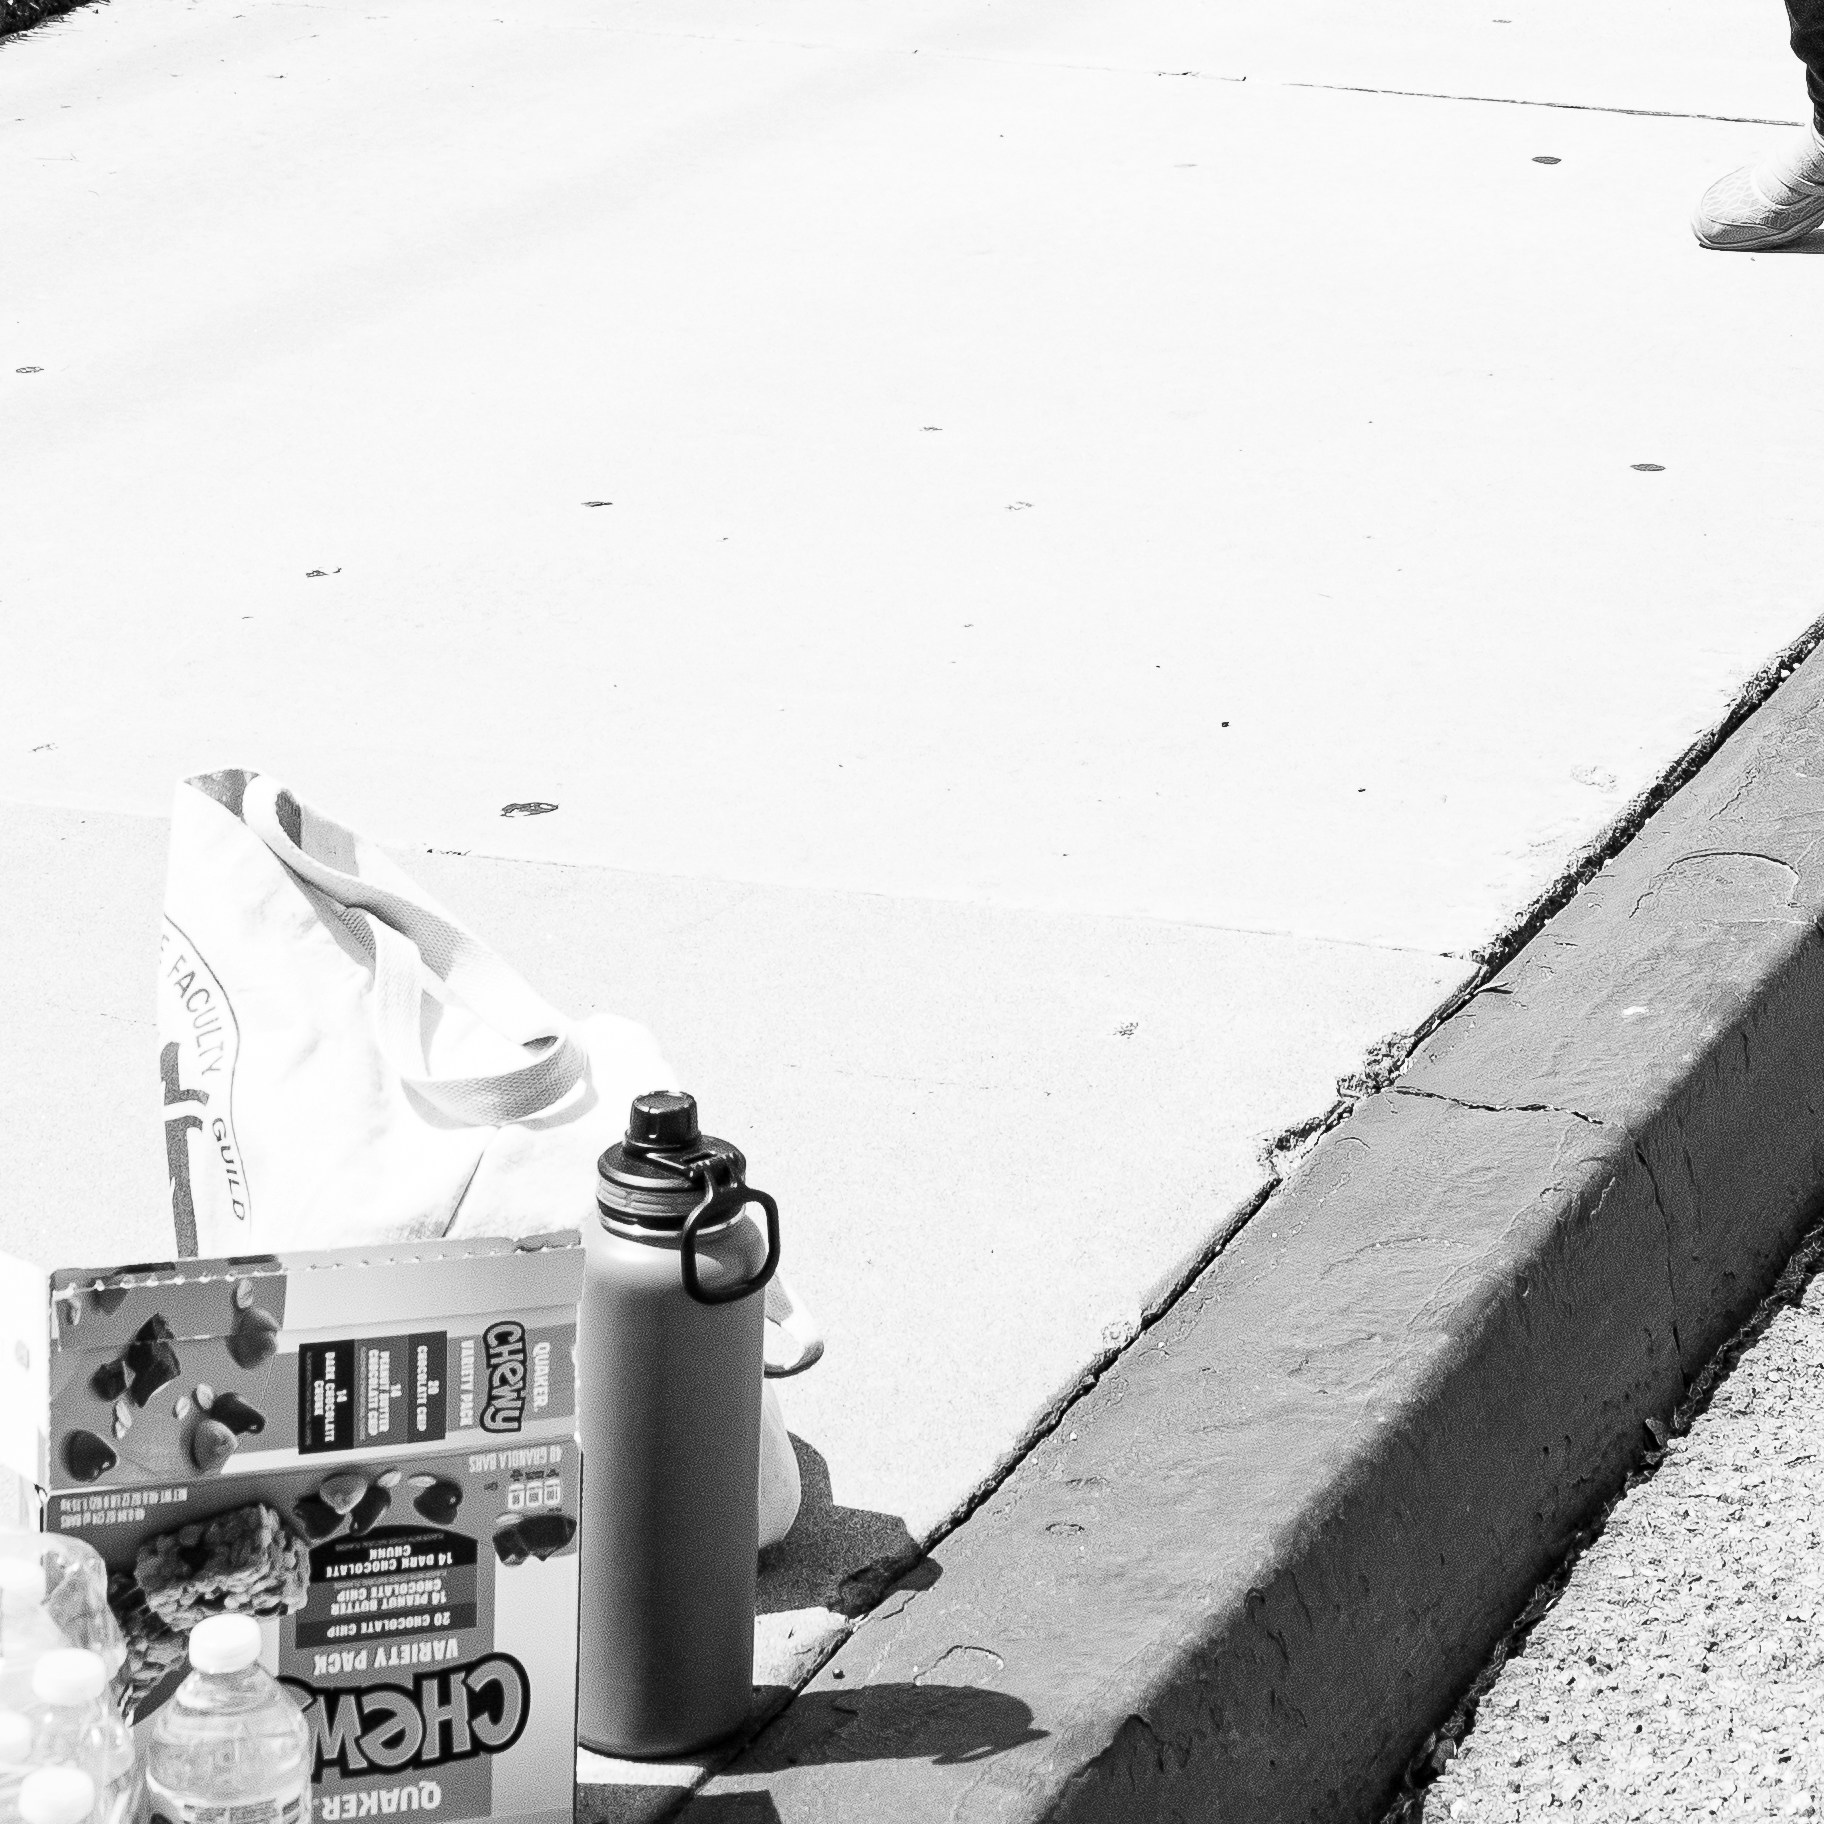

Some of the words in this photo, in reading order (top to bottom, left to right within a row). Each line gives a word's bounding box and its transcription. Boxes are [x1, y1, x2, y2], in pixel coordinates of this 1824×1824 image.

[167, 954, 224, 1076] FACULTY
[211, 1117, 246, 1221] GUILD
[326, 1558, 398, 1578] CHOCOLATE
[438, 1552, 453, 1566] 14
[336, 1587, 368, 1603] CHIP
[369, 1578, 442, 1599] CHOCOLATE
[360, 1614, 431, 1634] CHOCOLATE
[434, 1612, 451, 1627] 20
[326, 1623, 357, 1638] CHIP
[313, 1649, 368, 1676] PACK
[374, 1637, 459, 1669] VARIETY
